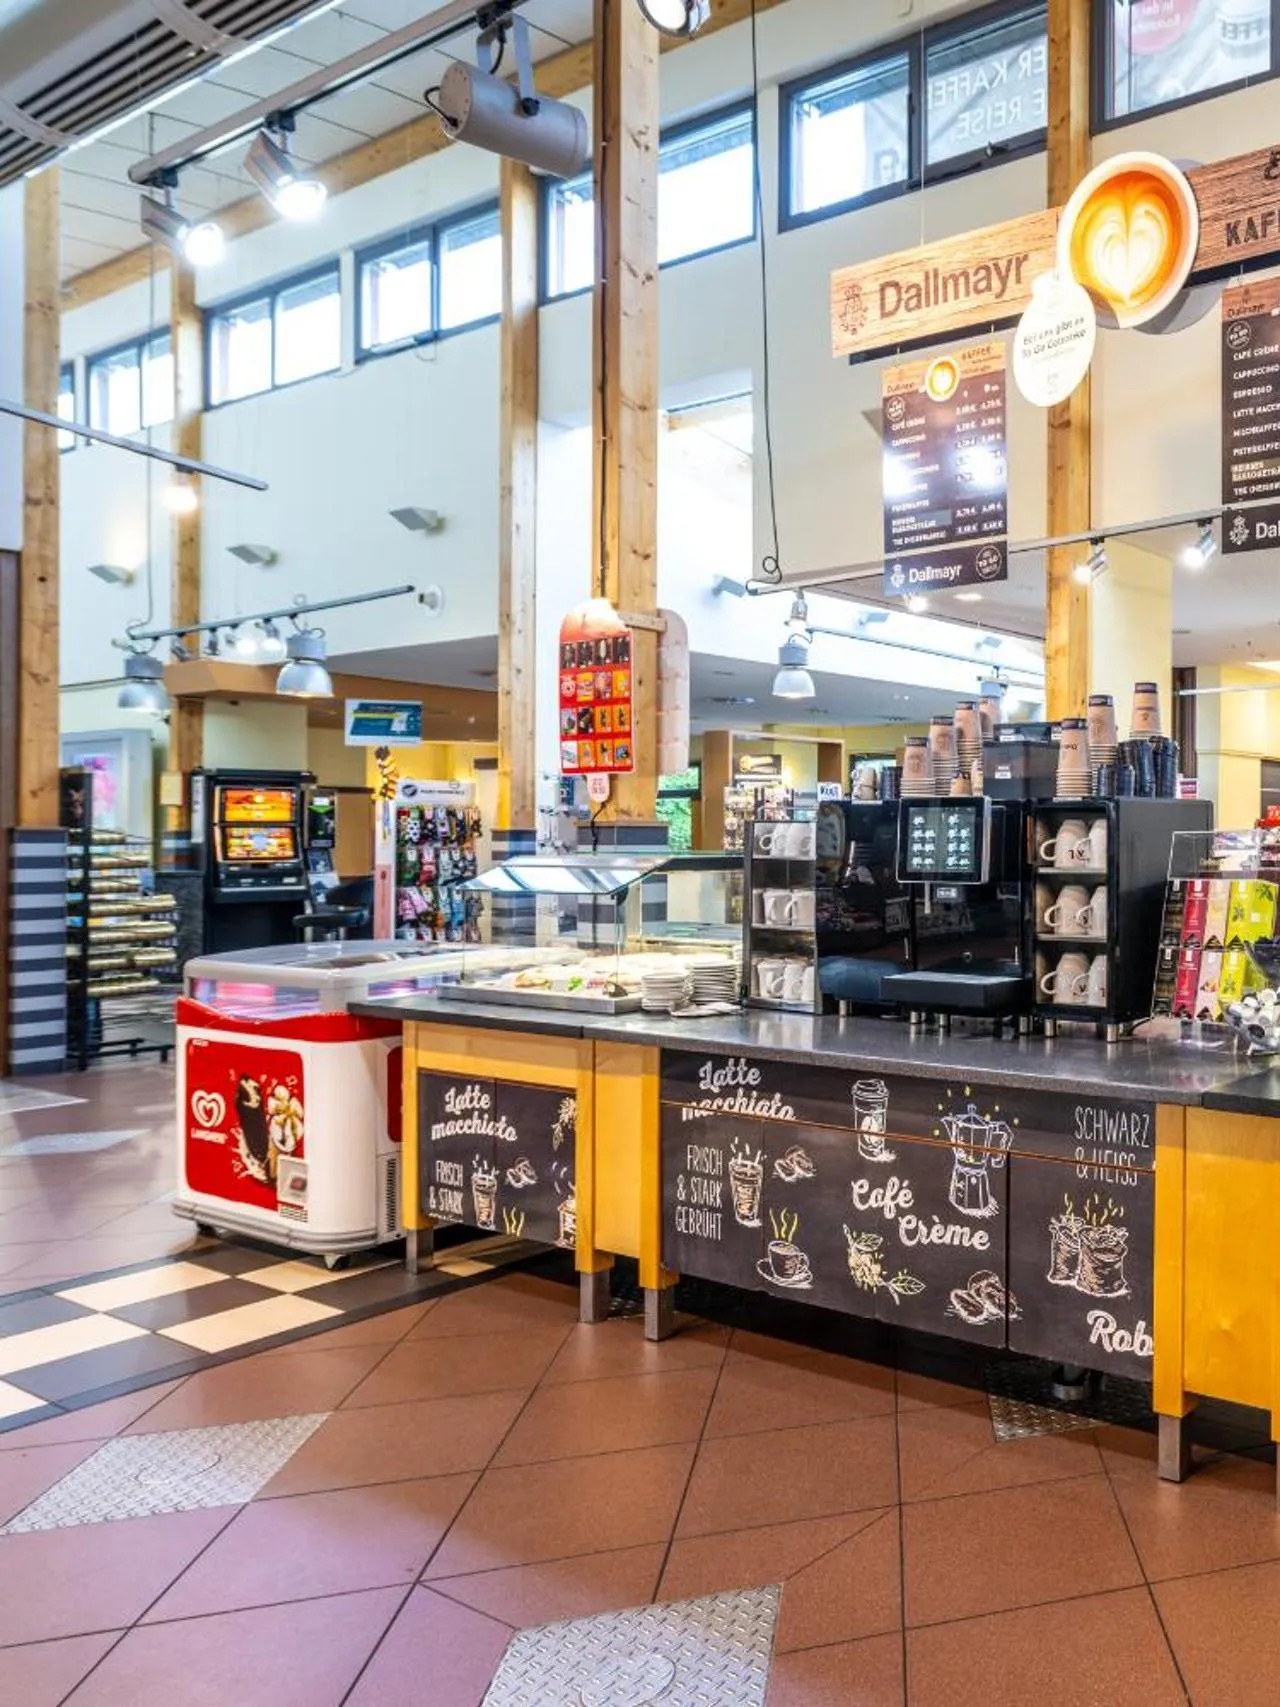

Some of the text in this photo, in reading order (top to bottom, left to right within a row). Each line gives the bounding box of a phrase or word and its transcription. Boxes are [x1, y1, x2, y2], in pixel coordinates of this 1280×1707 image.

[878, 254, 1029, 320] Dallmayr
[909, 564, 962, 583] Dallmayr
[697, 1057, 762, 1094] Latte
[444, 1084, 491, 1116] Latte
[431, 1110, 518, 1141] macchiato
[1074, 1105, 1150, 1148] SCHWARZ
[435, 1159, 464, 1188] FRISCH
[686, 1143, 723, 1177] FRISCH
[1092, 1147, 1138, 1187] HEISS
[438, 1187, 464, 1216] STARK
[676, 1173, 723, 1209] & STARK
[850, 1176, 915, 1220] Café
[675, 1203, 722, 1242] GEBRÜHT
[897, 1214, 992, 1251] Crème
